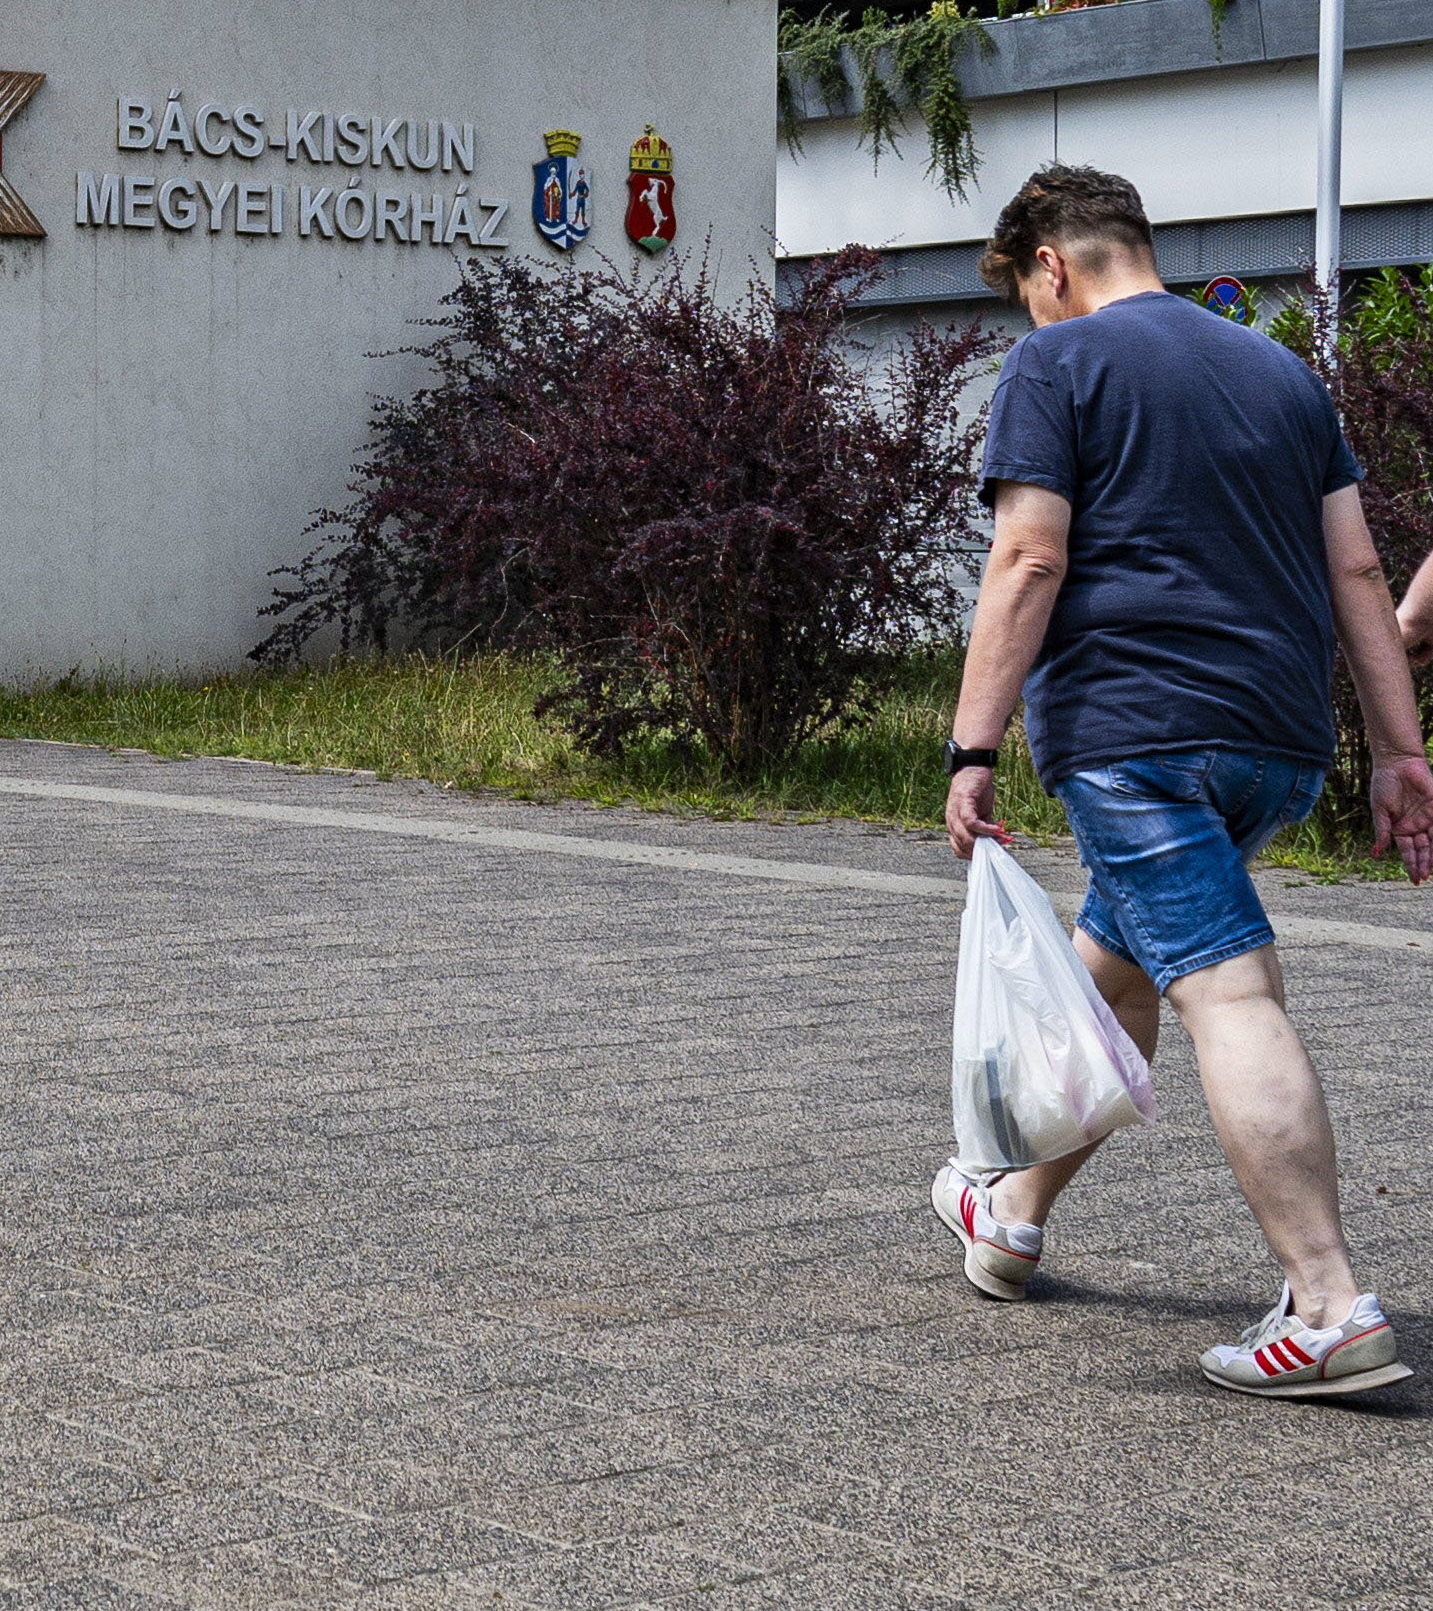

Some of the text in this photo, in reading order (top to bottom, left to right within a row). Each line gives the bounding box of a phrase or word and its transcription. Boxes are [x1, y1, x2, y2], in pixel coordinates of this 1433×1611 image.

[117, 89, 475, 172] BÁCS-KISKUN
[74, 171, 510, 248] MEGYEI KÓRHÁZ
